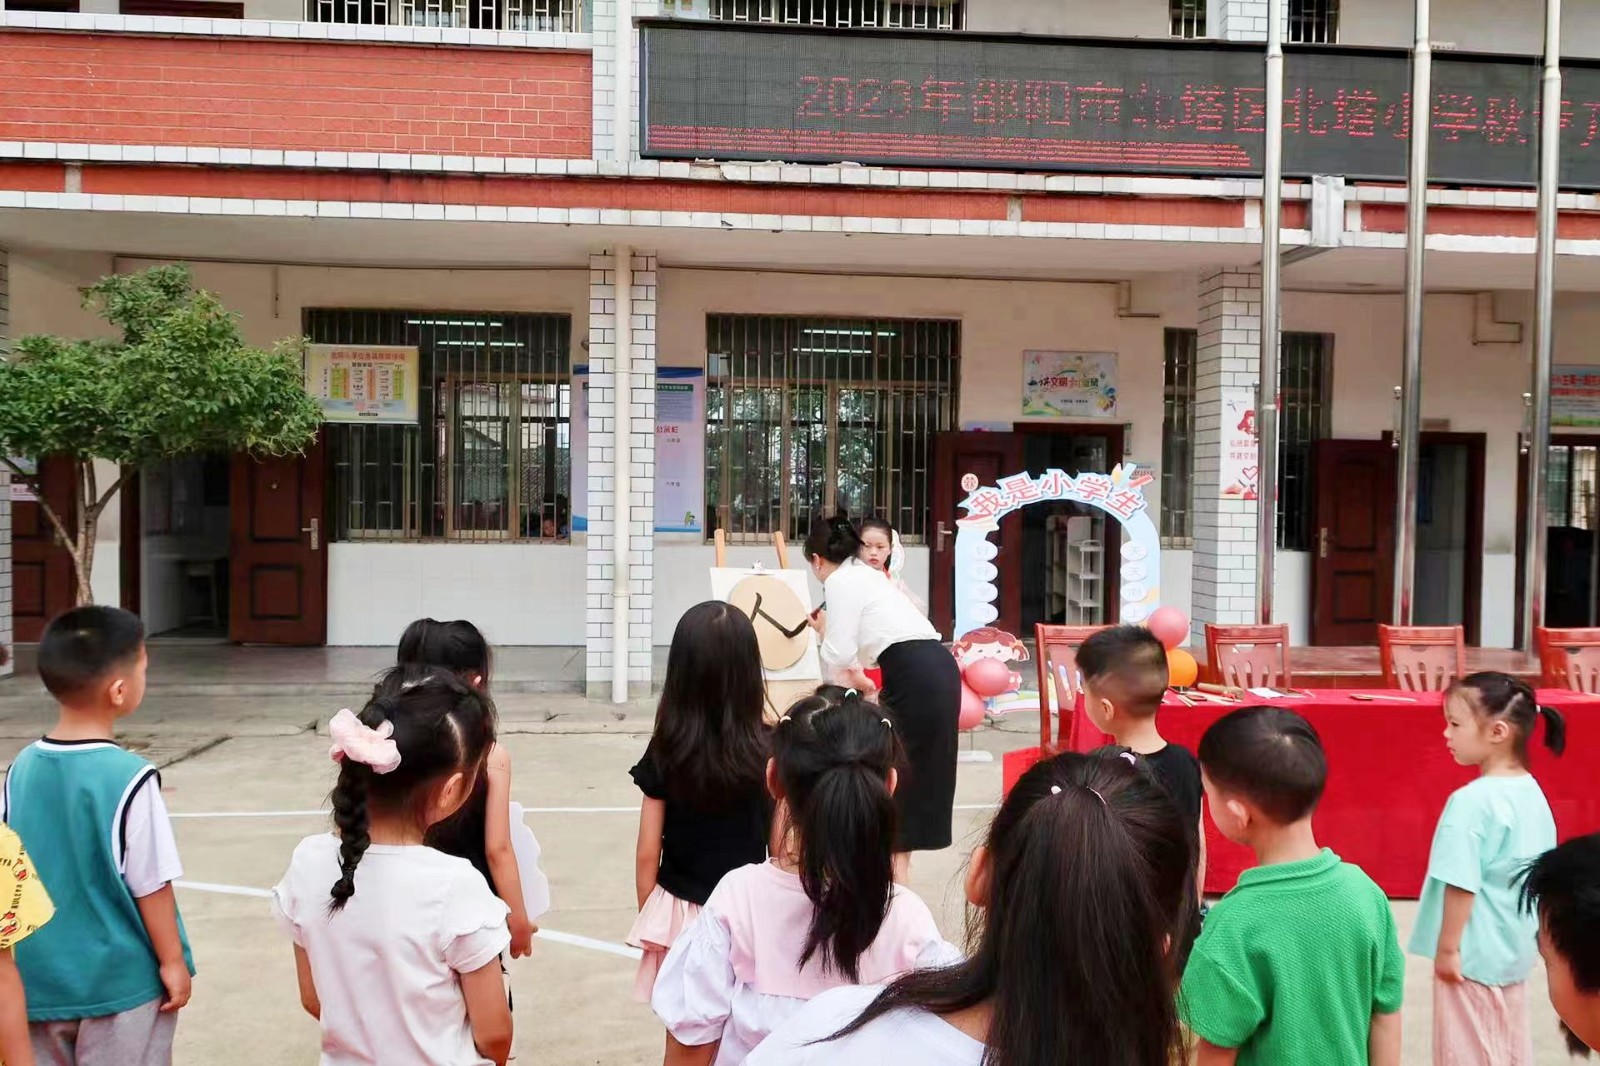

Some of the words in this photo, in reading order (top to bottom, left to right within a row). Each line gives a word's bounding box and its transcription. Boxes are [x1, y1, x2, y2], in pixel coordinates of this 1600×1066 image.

[970, 473, 1142, 518] 我是小学生
